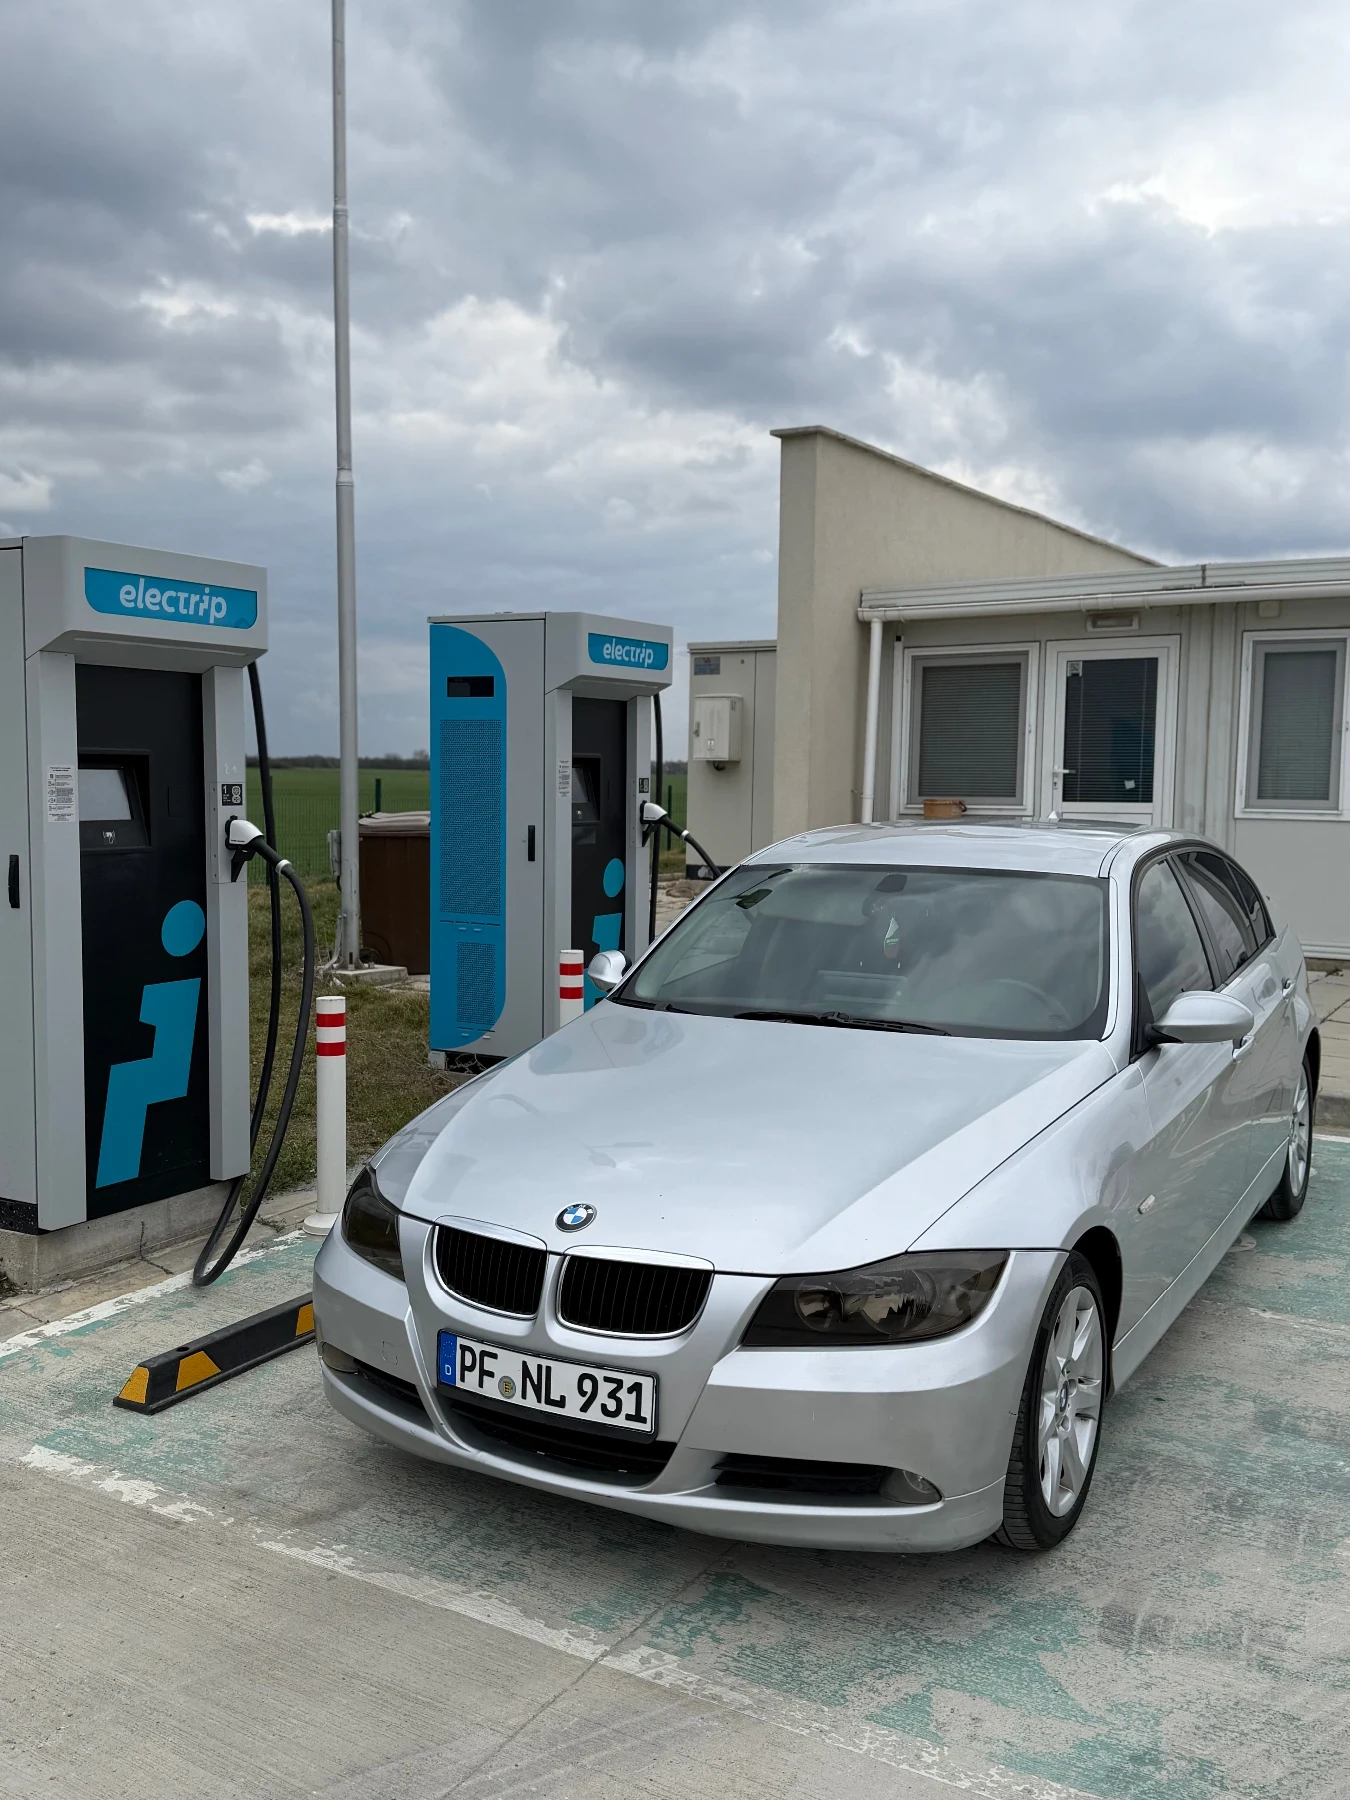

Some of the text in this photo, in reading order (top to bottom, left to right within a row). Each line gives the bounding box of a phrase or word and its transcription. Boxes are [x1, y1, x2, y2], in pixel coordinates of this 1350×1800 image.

[119, 577, 228, 624] electrip
[603, 638, 654, 668] electrip
[459, 1343, 648, 1424] PF NL 931
